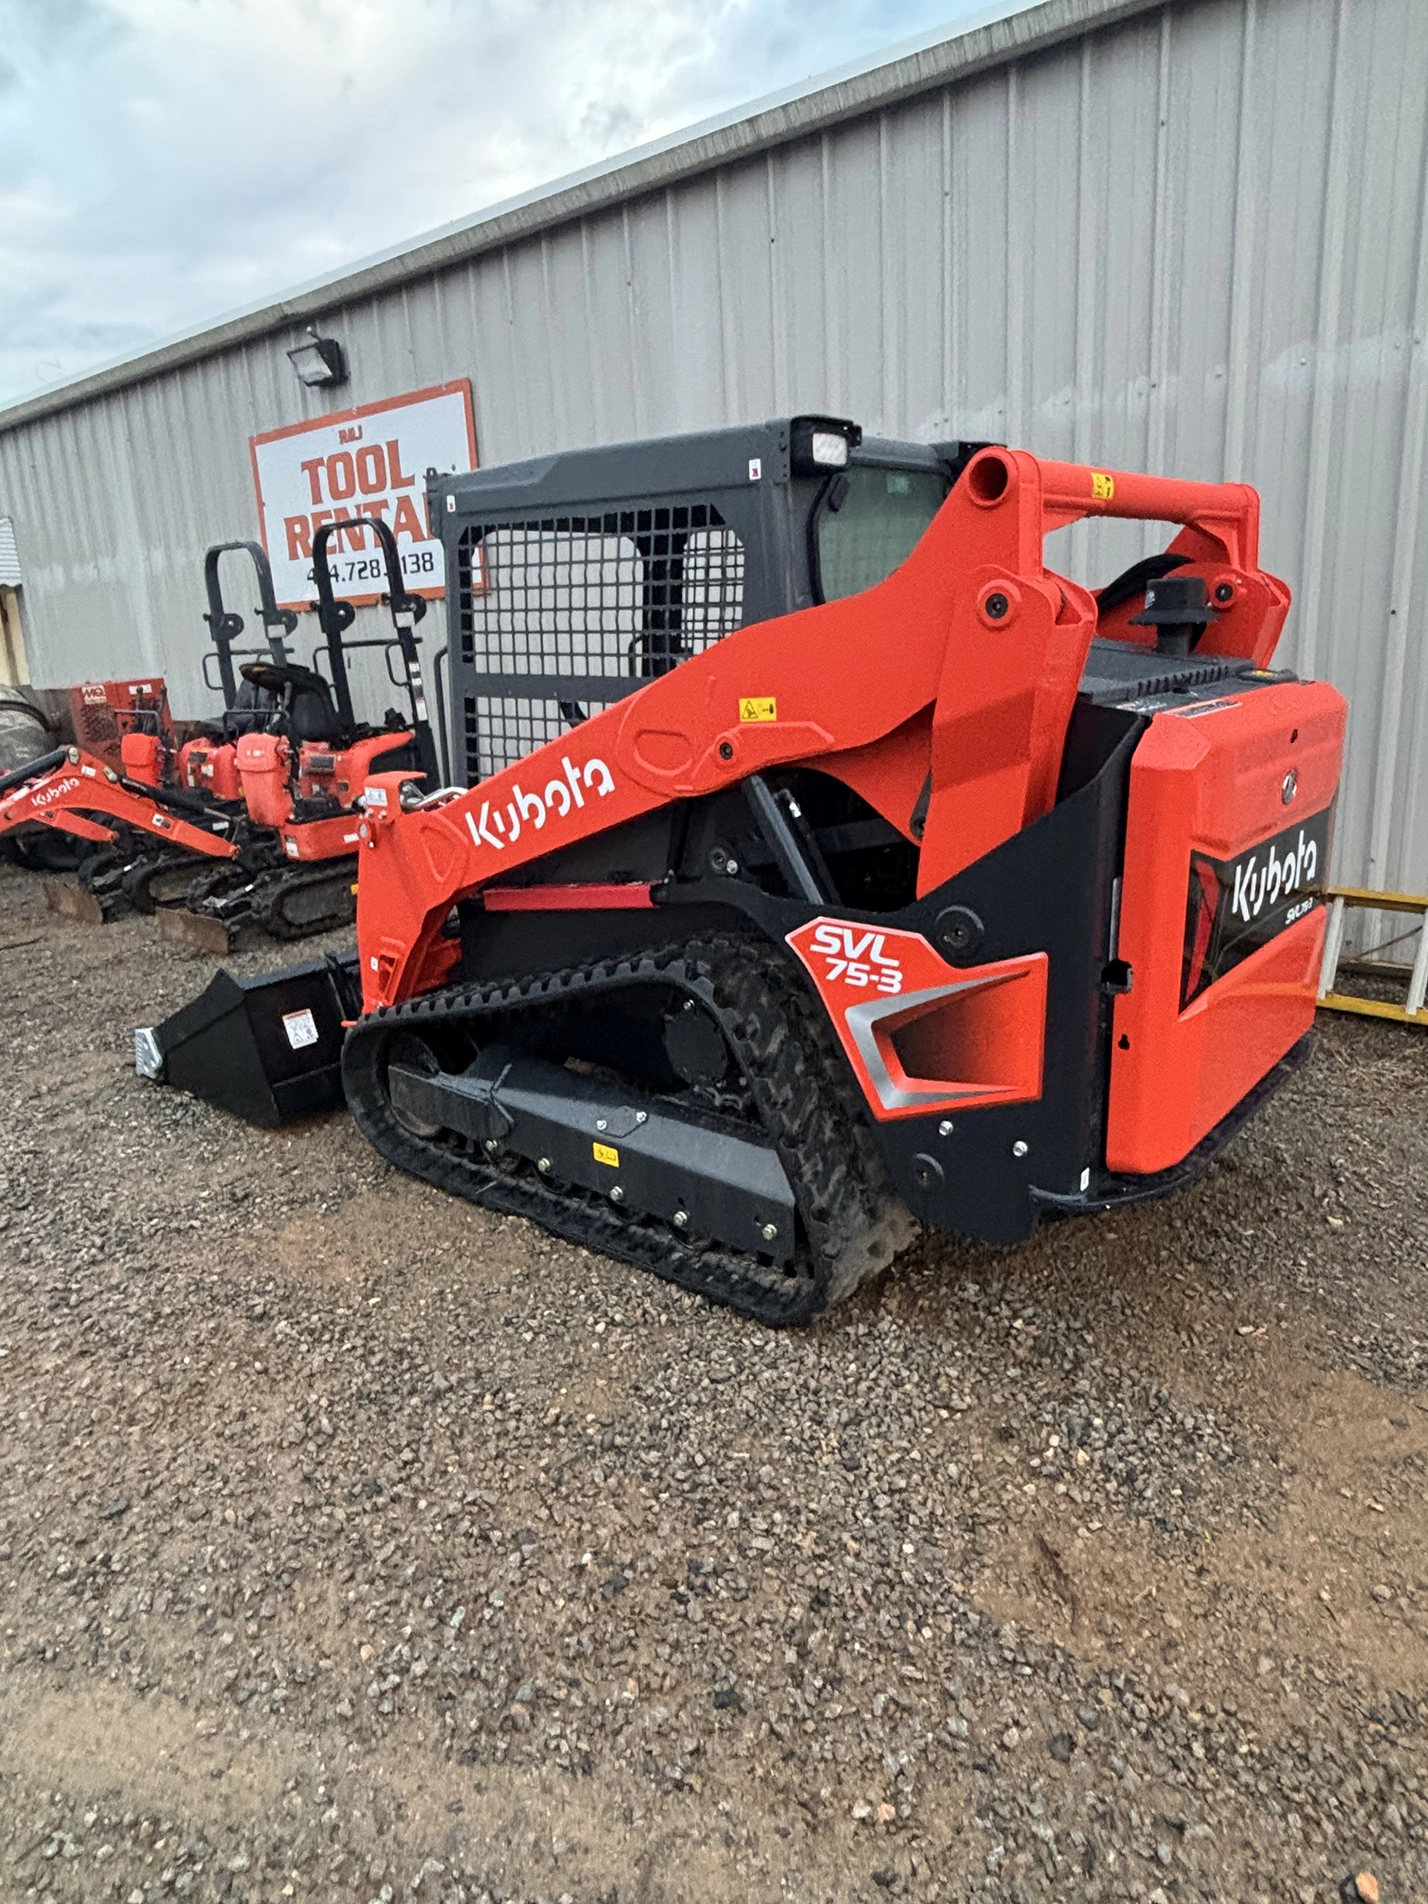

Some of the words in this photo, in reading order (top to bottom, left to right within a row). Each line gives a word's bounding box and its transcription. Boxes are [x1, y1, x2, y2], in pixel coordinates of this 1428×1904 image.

[301, 439, 415, 505] TOOL
[307, 552, 434, 583] 44.728.138
[81, 687, 106, 699] MQ
[31, 777, 81, 807] Kubota
[465, 756, 615, 849] Kubota
[1231, 829, 1317, 922] Kubota
[809, 925, 900, 968] SVL
[825, 957, 903, 994] 75-3
